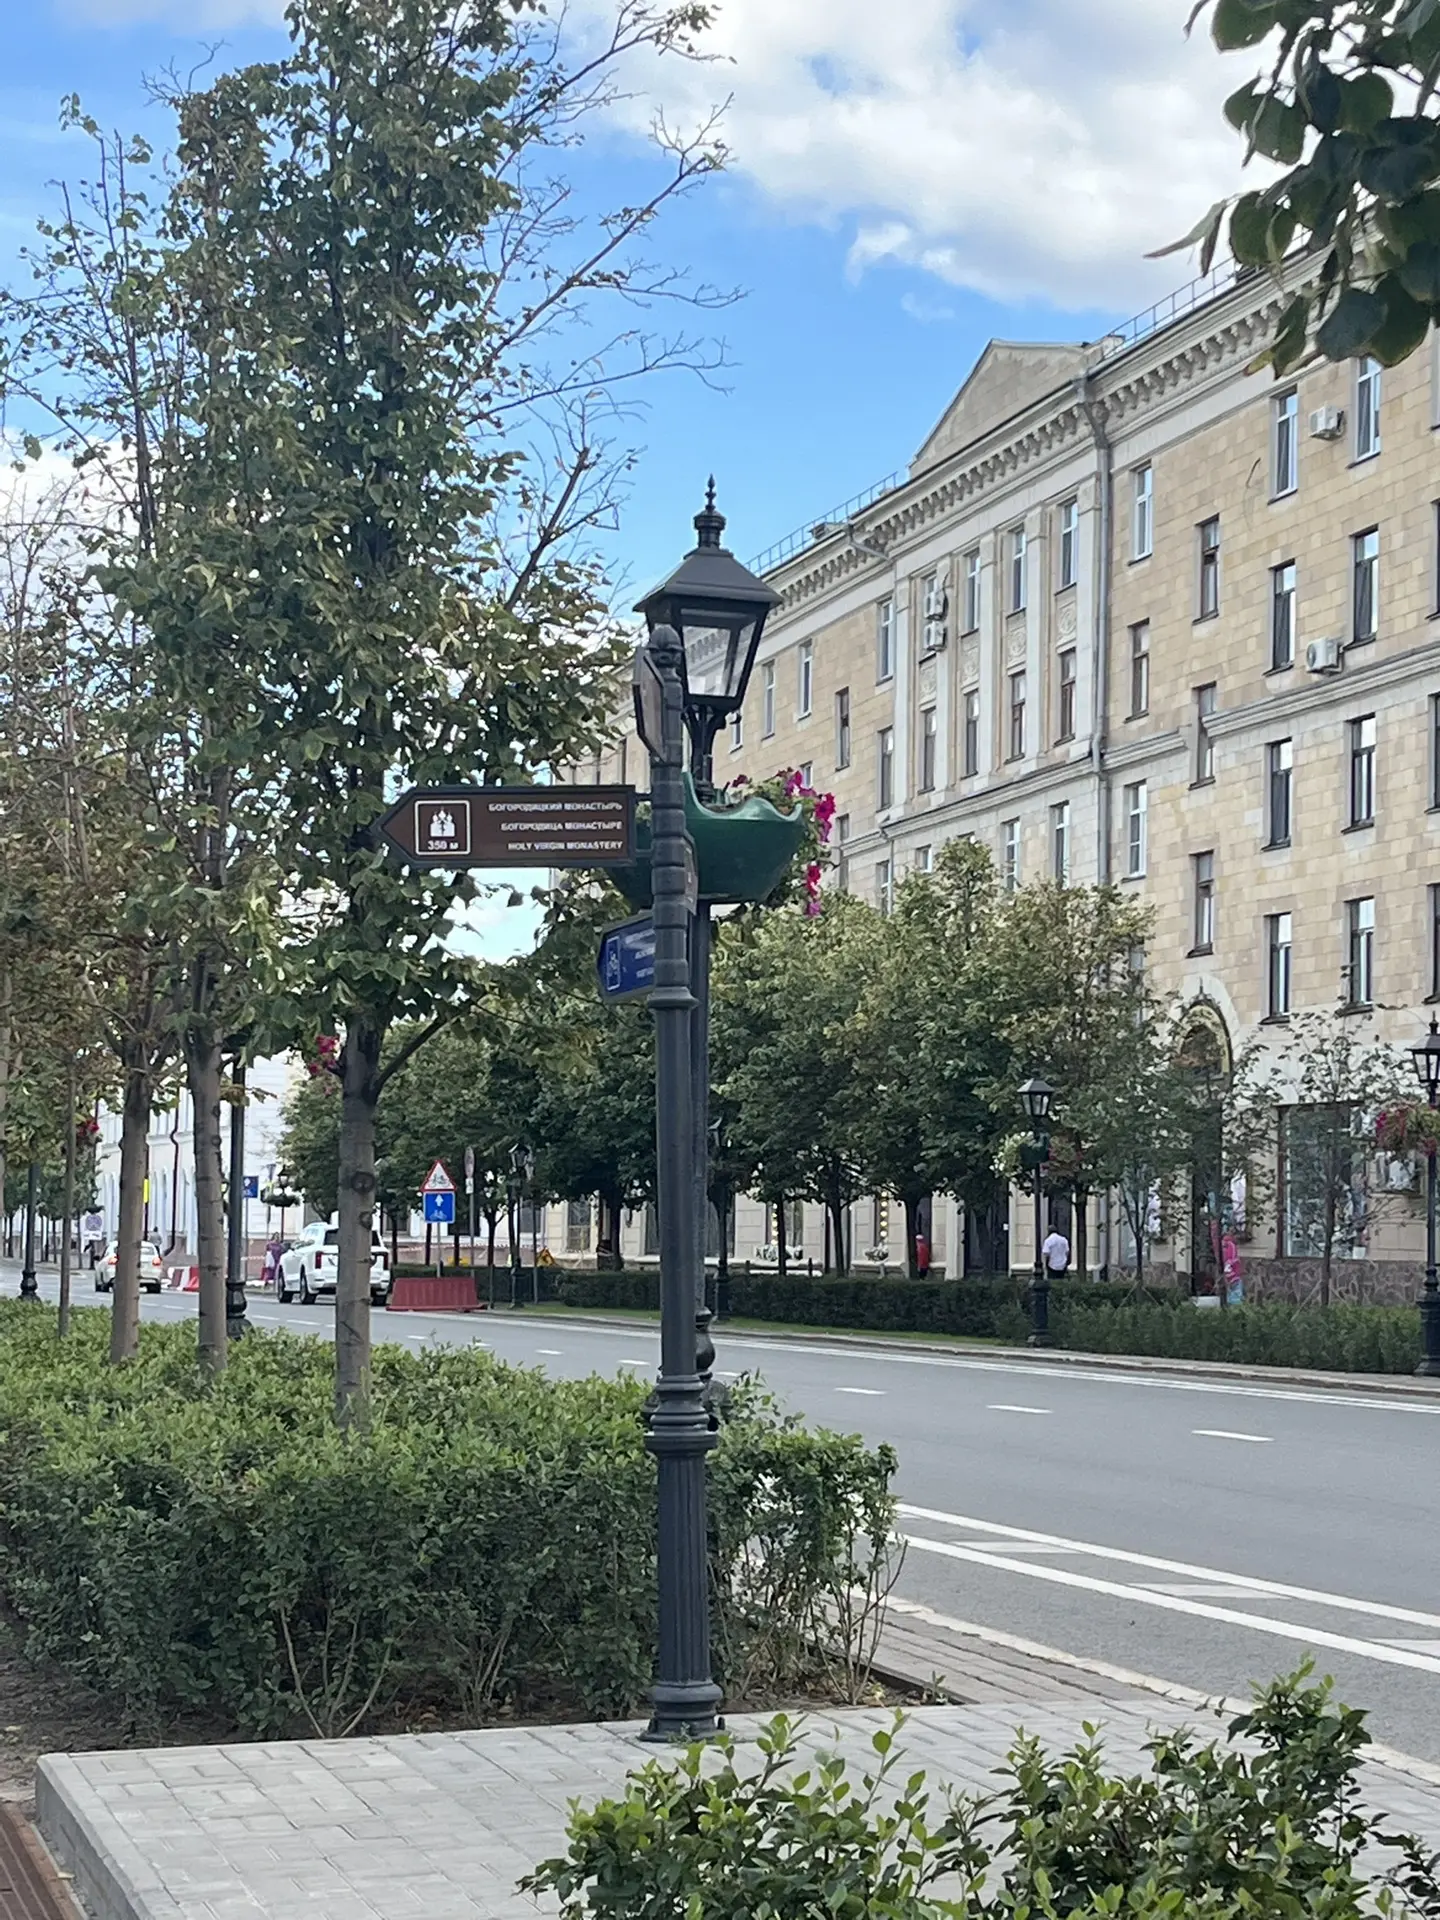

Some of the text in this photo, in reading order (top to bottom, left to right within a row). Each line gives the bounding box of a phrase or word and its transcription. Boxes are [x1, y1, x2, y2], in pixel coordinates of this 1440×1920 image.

[488, 802, 623, 812] БОГОРОДИЦКИЙ МОНАСТЫРЬ
[501, 821, 622, 831] БОГОРОДИЦА МОНАСТЫРЕ
[427, 840, 448, 850] 350
[508, 841, 623, 850] HOLY VIRGIN MONASTERY
